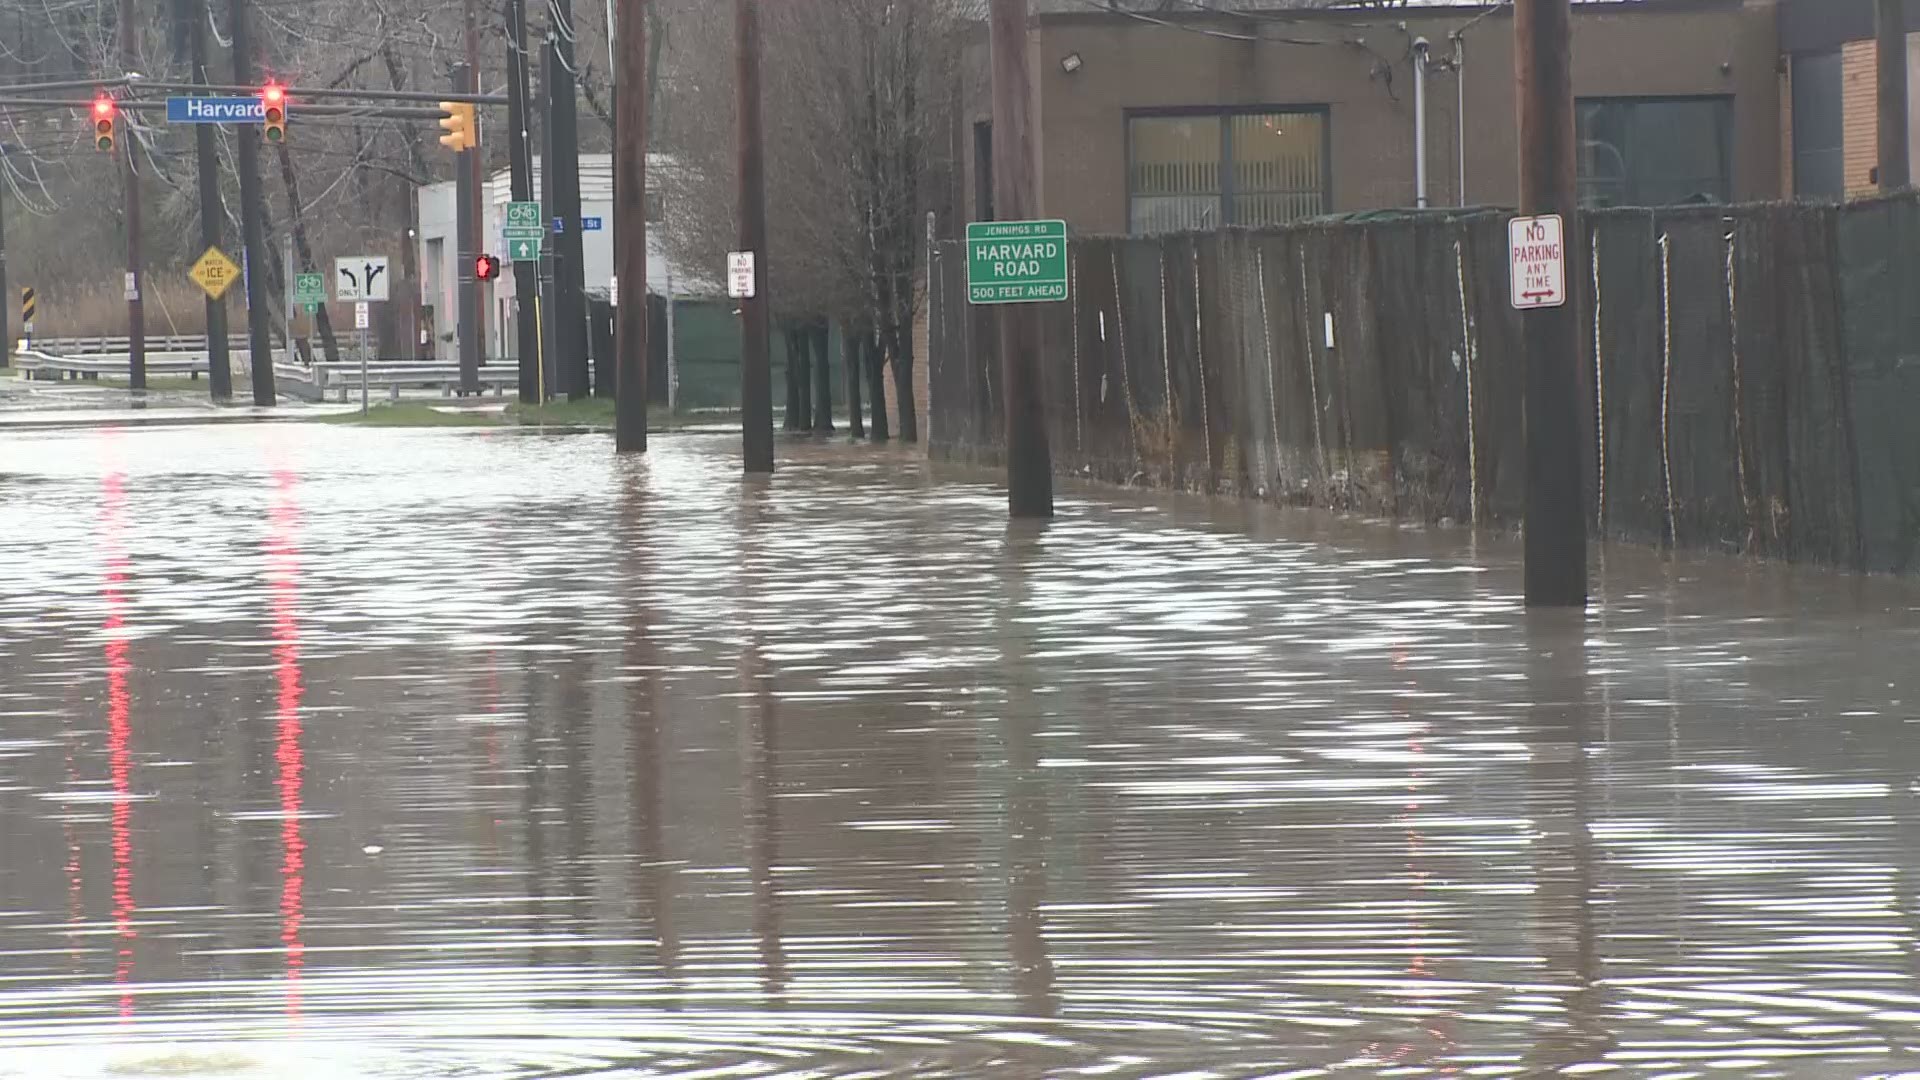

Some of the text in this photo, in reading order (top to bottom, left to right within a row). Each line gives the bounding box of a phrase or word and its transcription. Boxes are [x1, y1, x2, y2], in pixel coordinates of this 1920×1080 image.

[187, 100, 265, 117] Harvard
[587, 220, 598, 228] St
[985, 225, 1047, 236] JENNINGS RD
[1526, 225, 1545, 241] NO
[976, 243, 1057, 261] HARVARD
[1514, 244, 1559, 263] PARKING
[206, 267, 224, 278] ICE
[994, 261, 1040, 277] ROAD
[1527, 263, 1548, 275] ANY
[1525, 276, 1551, 288] TIME
[338, 289, 359, 297] ONLY
[973, 284, 1063, 299] 500 FEET AHEAD
